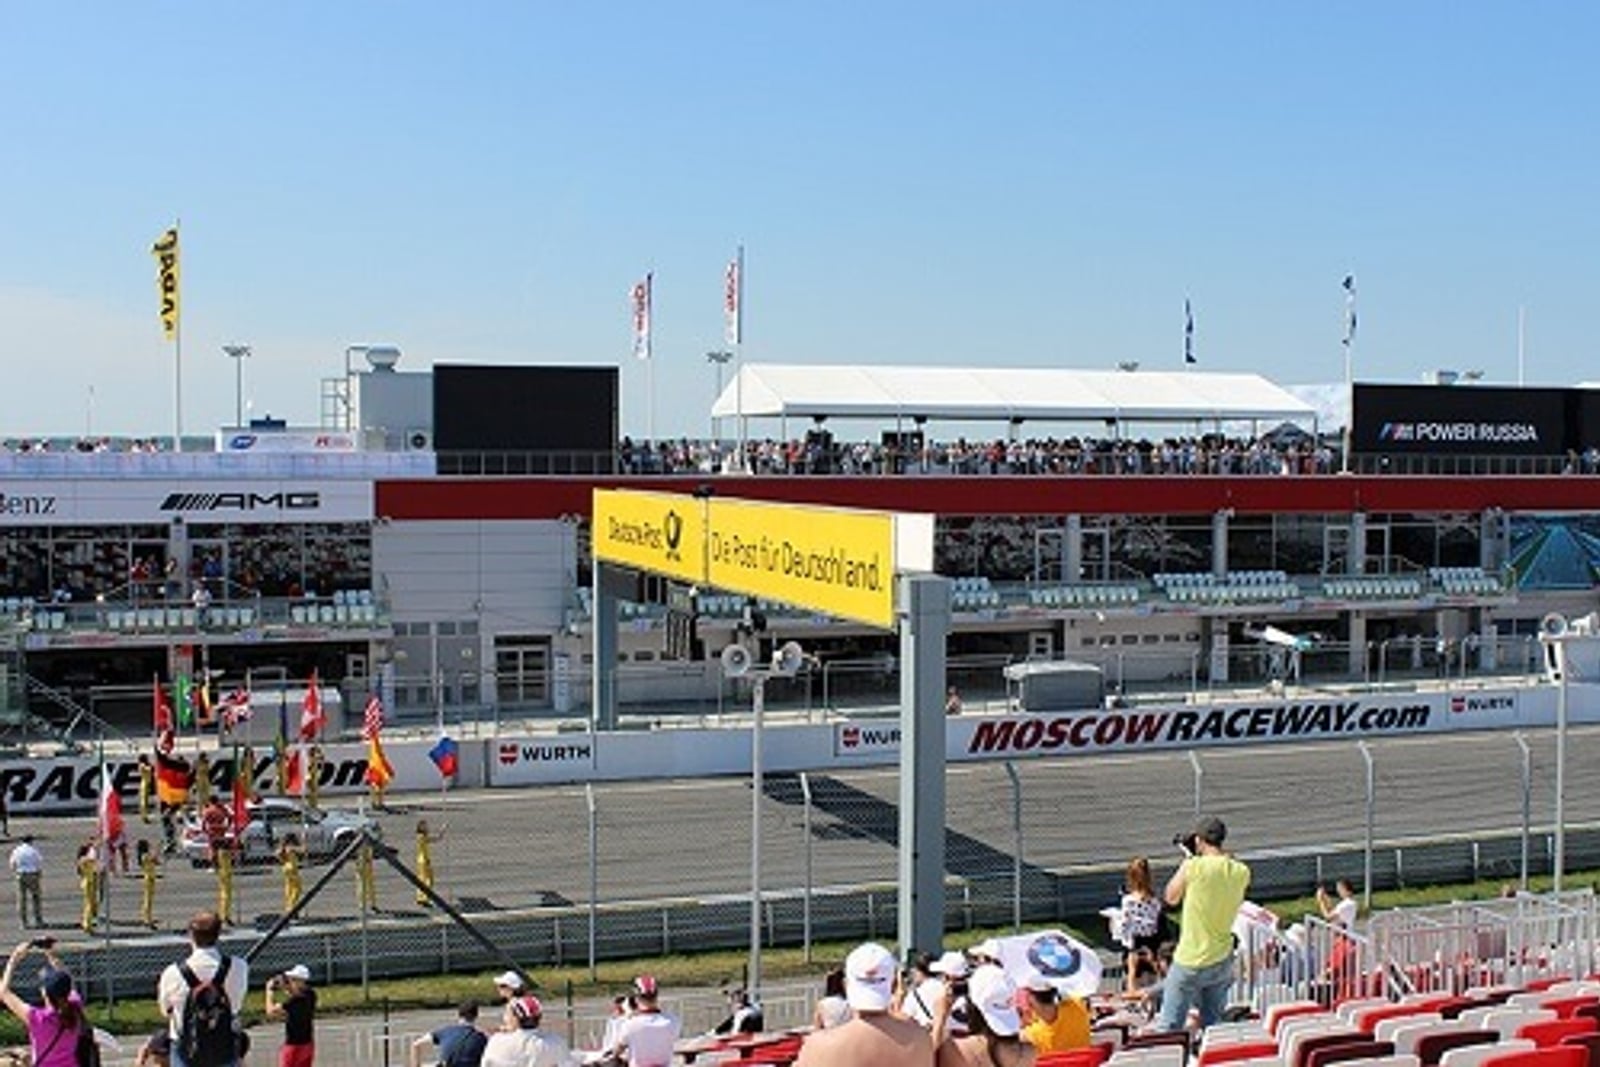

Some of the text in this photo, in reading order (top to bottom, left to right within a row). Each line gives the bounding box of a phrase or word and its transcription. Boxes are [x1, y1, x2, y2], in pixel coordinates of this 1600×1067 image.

[1416, 422, 1475, 441] POWER
[1478, 422, 1538, 442] RUSSIA
[209, 492, 320, 511] AMG
[712, 531, 731, 565] Die
[733, 534, 757, 570] Post
[782, 540, 884, 592] Deutschland.
[861, 728, 902, 745] WUR
